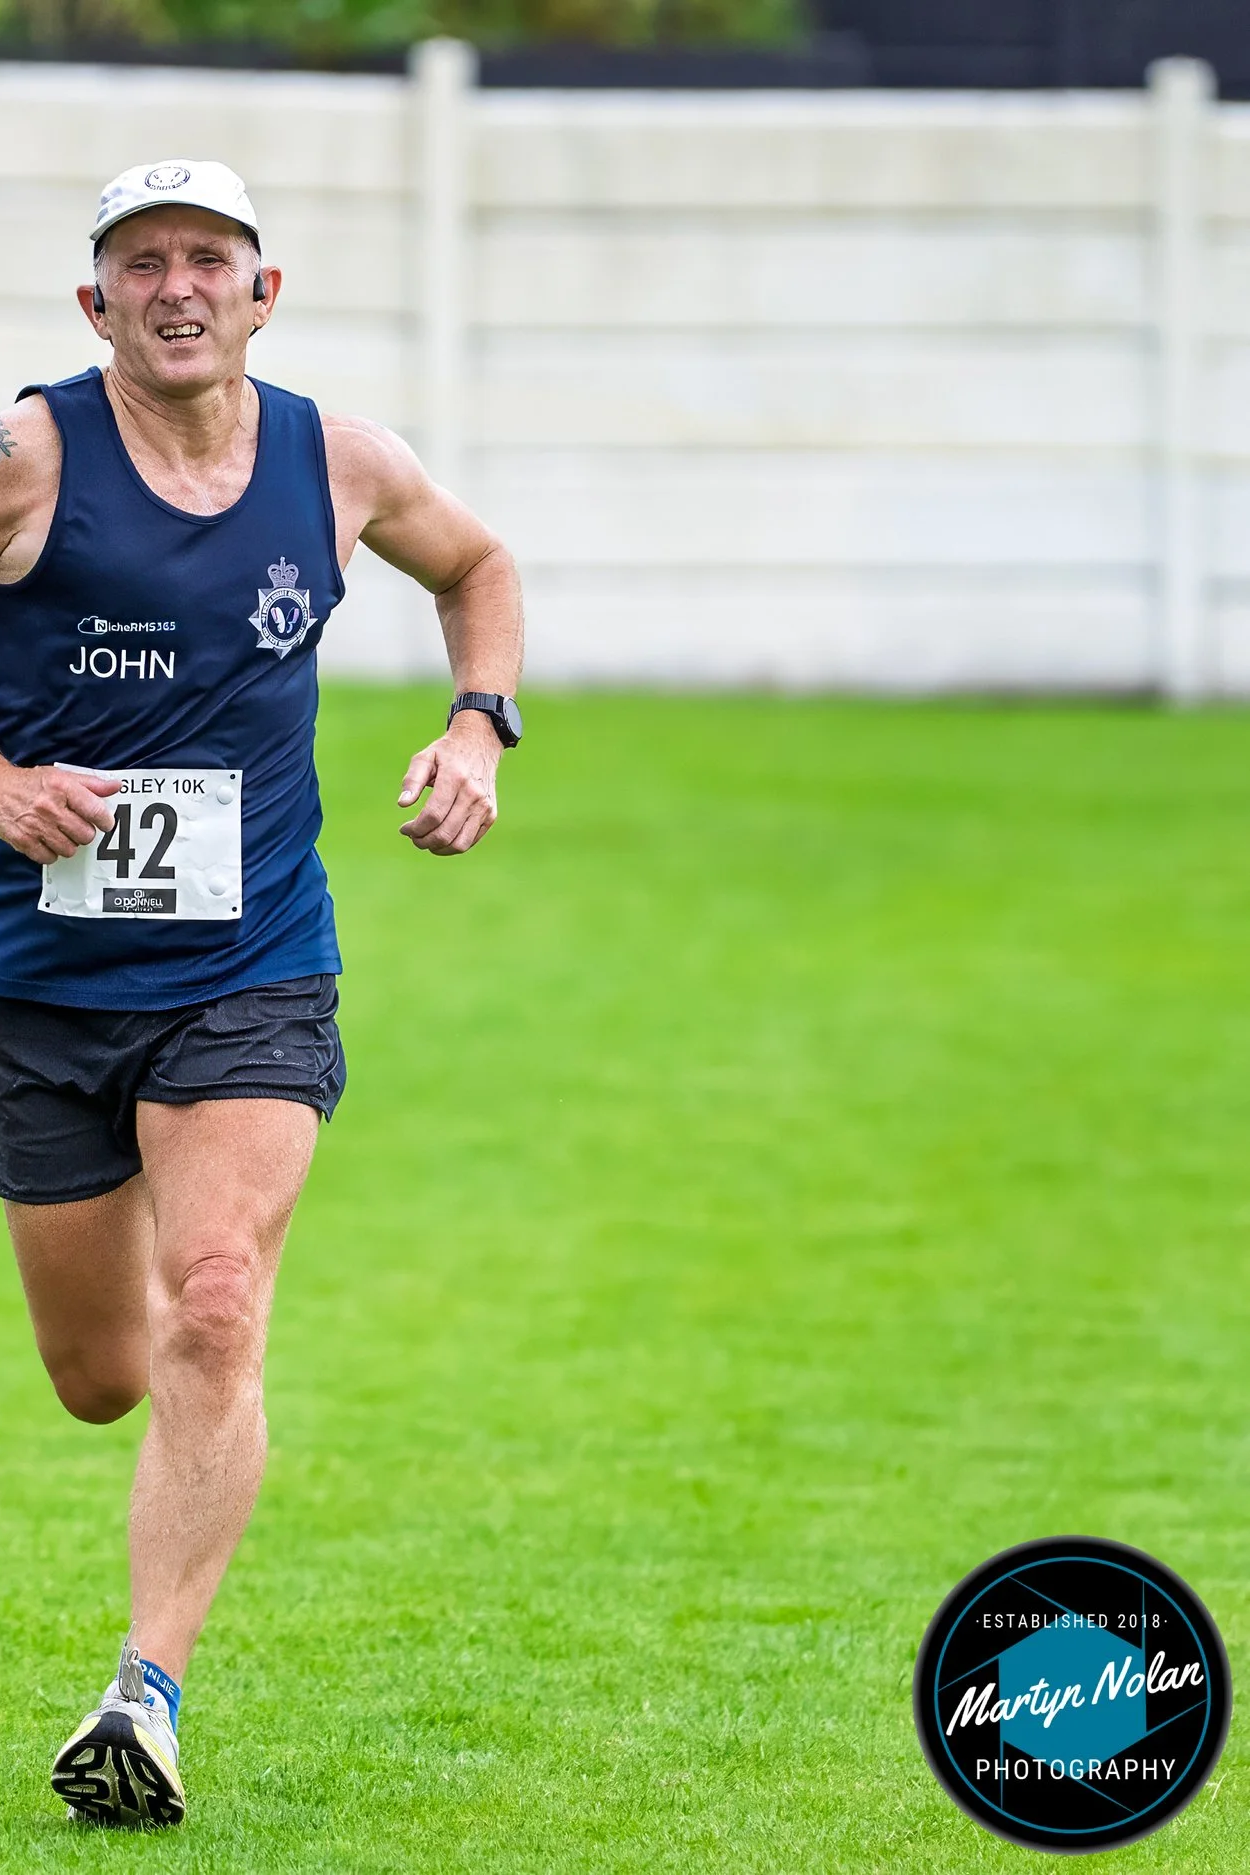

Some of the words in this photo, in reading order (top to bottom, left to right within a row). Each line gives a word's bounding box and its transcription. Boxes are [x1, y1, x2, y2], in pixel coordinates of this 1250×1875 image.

[69, 646, 175, 679] JOHN
[119, 778, 166, 794] SLEY
[172, 779, 205, 794] 10K
[96, 802, 178, 879] 42
